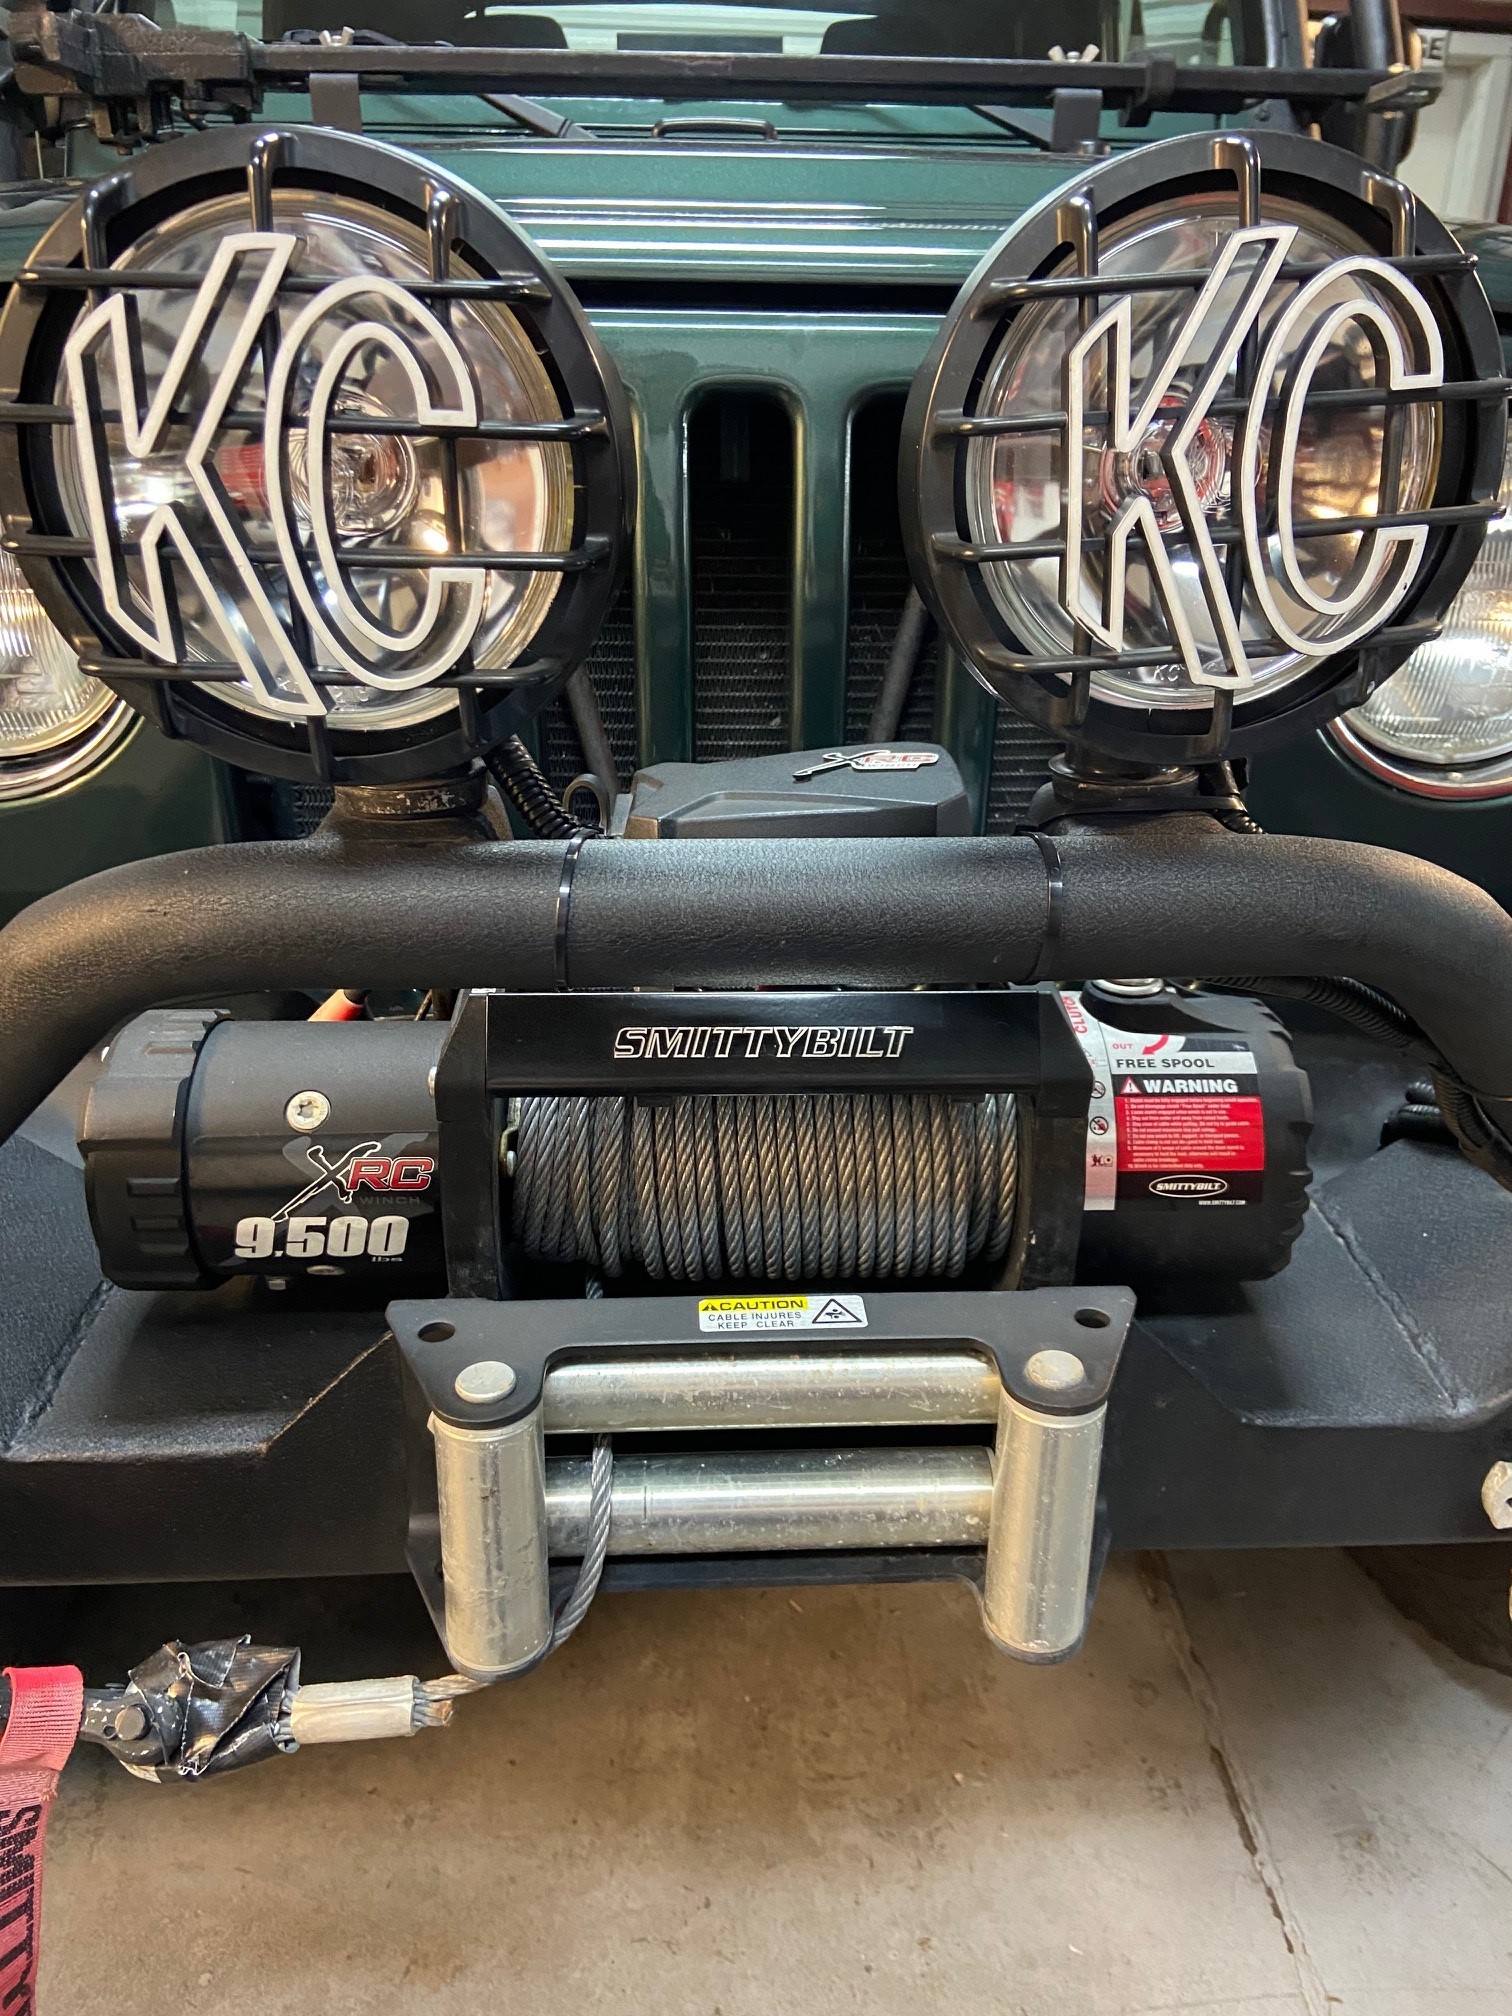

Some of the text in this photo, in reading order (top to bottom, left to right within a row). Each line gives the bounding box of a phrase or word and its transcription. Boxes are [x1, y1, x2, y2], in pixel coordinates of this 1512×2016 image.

[1066, 226, 1443, 690] KC
[66, 233, 486, 716] KC
[613, 1026, 914, 1059] SMITTYBILT
[1116, 1058, 1214, 1068] FREE SPOOL
[1142, 1079, 1239, 1094] WARNING
[1155, 1182, 1221, 1191] SMITTYBILT
[359, 1196, 420, 1204] WINCH
[719, 1300, 804, 1311] CAUTION
[708, 1312, 802, 1322] CABLE INJURES
[718, 1320, 795, 1330] KEEP CLEAR
